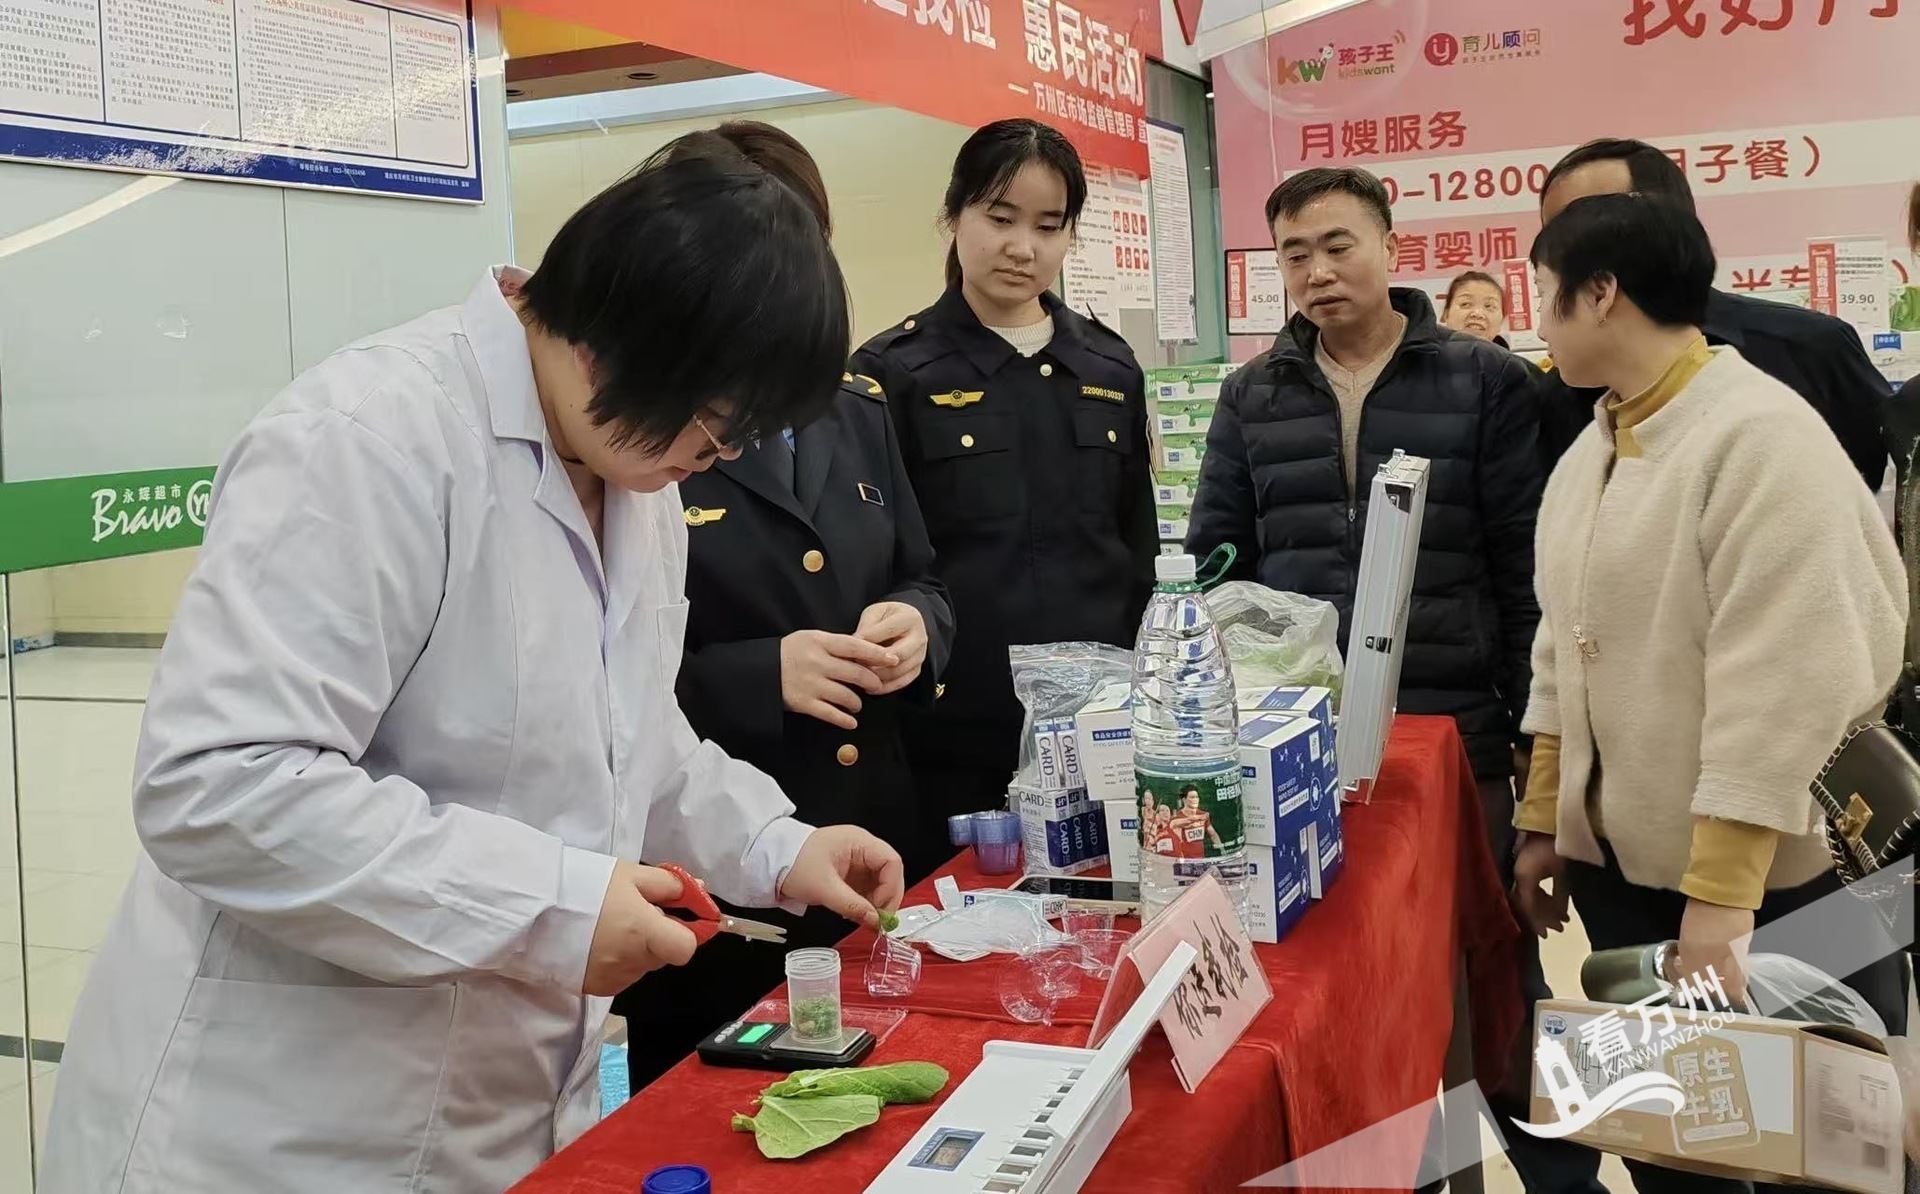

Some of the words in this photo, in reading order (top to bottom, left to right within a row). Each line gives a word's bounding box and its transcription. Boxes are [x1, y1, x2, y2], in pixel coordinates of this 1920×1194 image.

[1023, 0, 1145, 107] 惠民活动
[1338, 43, 1395, 66] 孩子王
[1462, 28, 1541, 54] 育儿顾问
[1338, 64, 1395, 81] kidswant
[1033, 82, 1135, 142] 万州区市场监督管理局
[1300, 111, 1468, 161] 月嫂服务
[1395, 227, 1518, 273] 育婴师
[1251, 294, 1279, 303] 45.00
[1840, 294, 1875, 304] 39.90
[91, 488, 184, 543] Bravo
[1039, 736, 1055, 776] CARD
[1061, 734, 1078, 774] CARD
[1019, 791, 1044, 807] CARD
[1059, 821, 1070, 855] CARD
[1073, 816, 1083, 849] CARD
[1087, 812, 1098, 846] CARD
[1187, 828, 1205, 840] CHN
[1673, 1047, 1735, 1087] 原生
